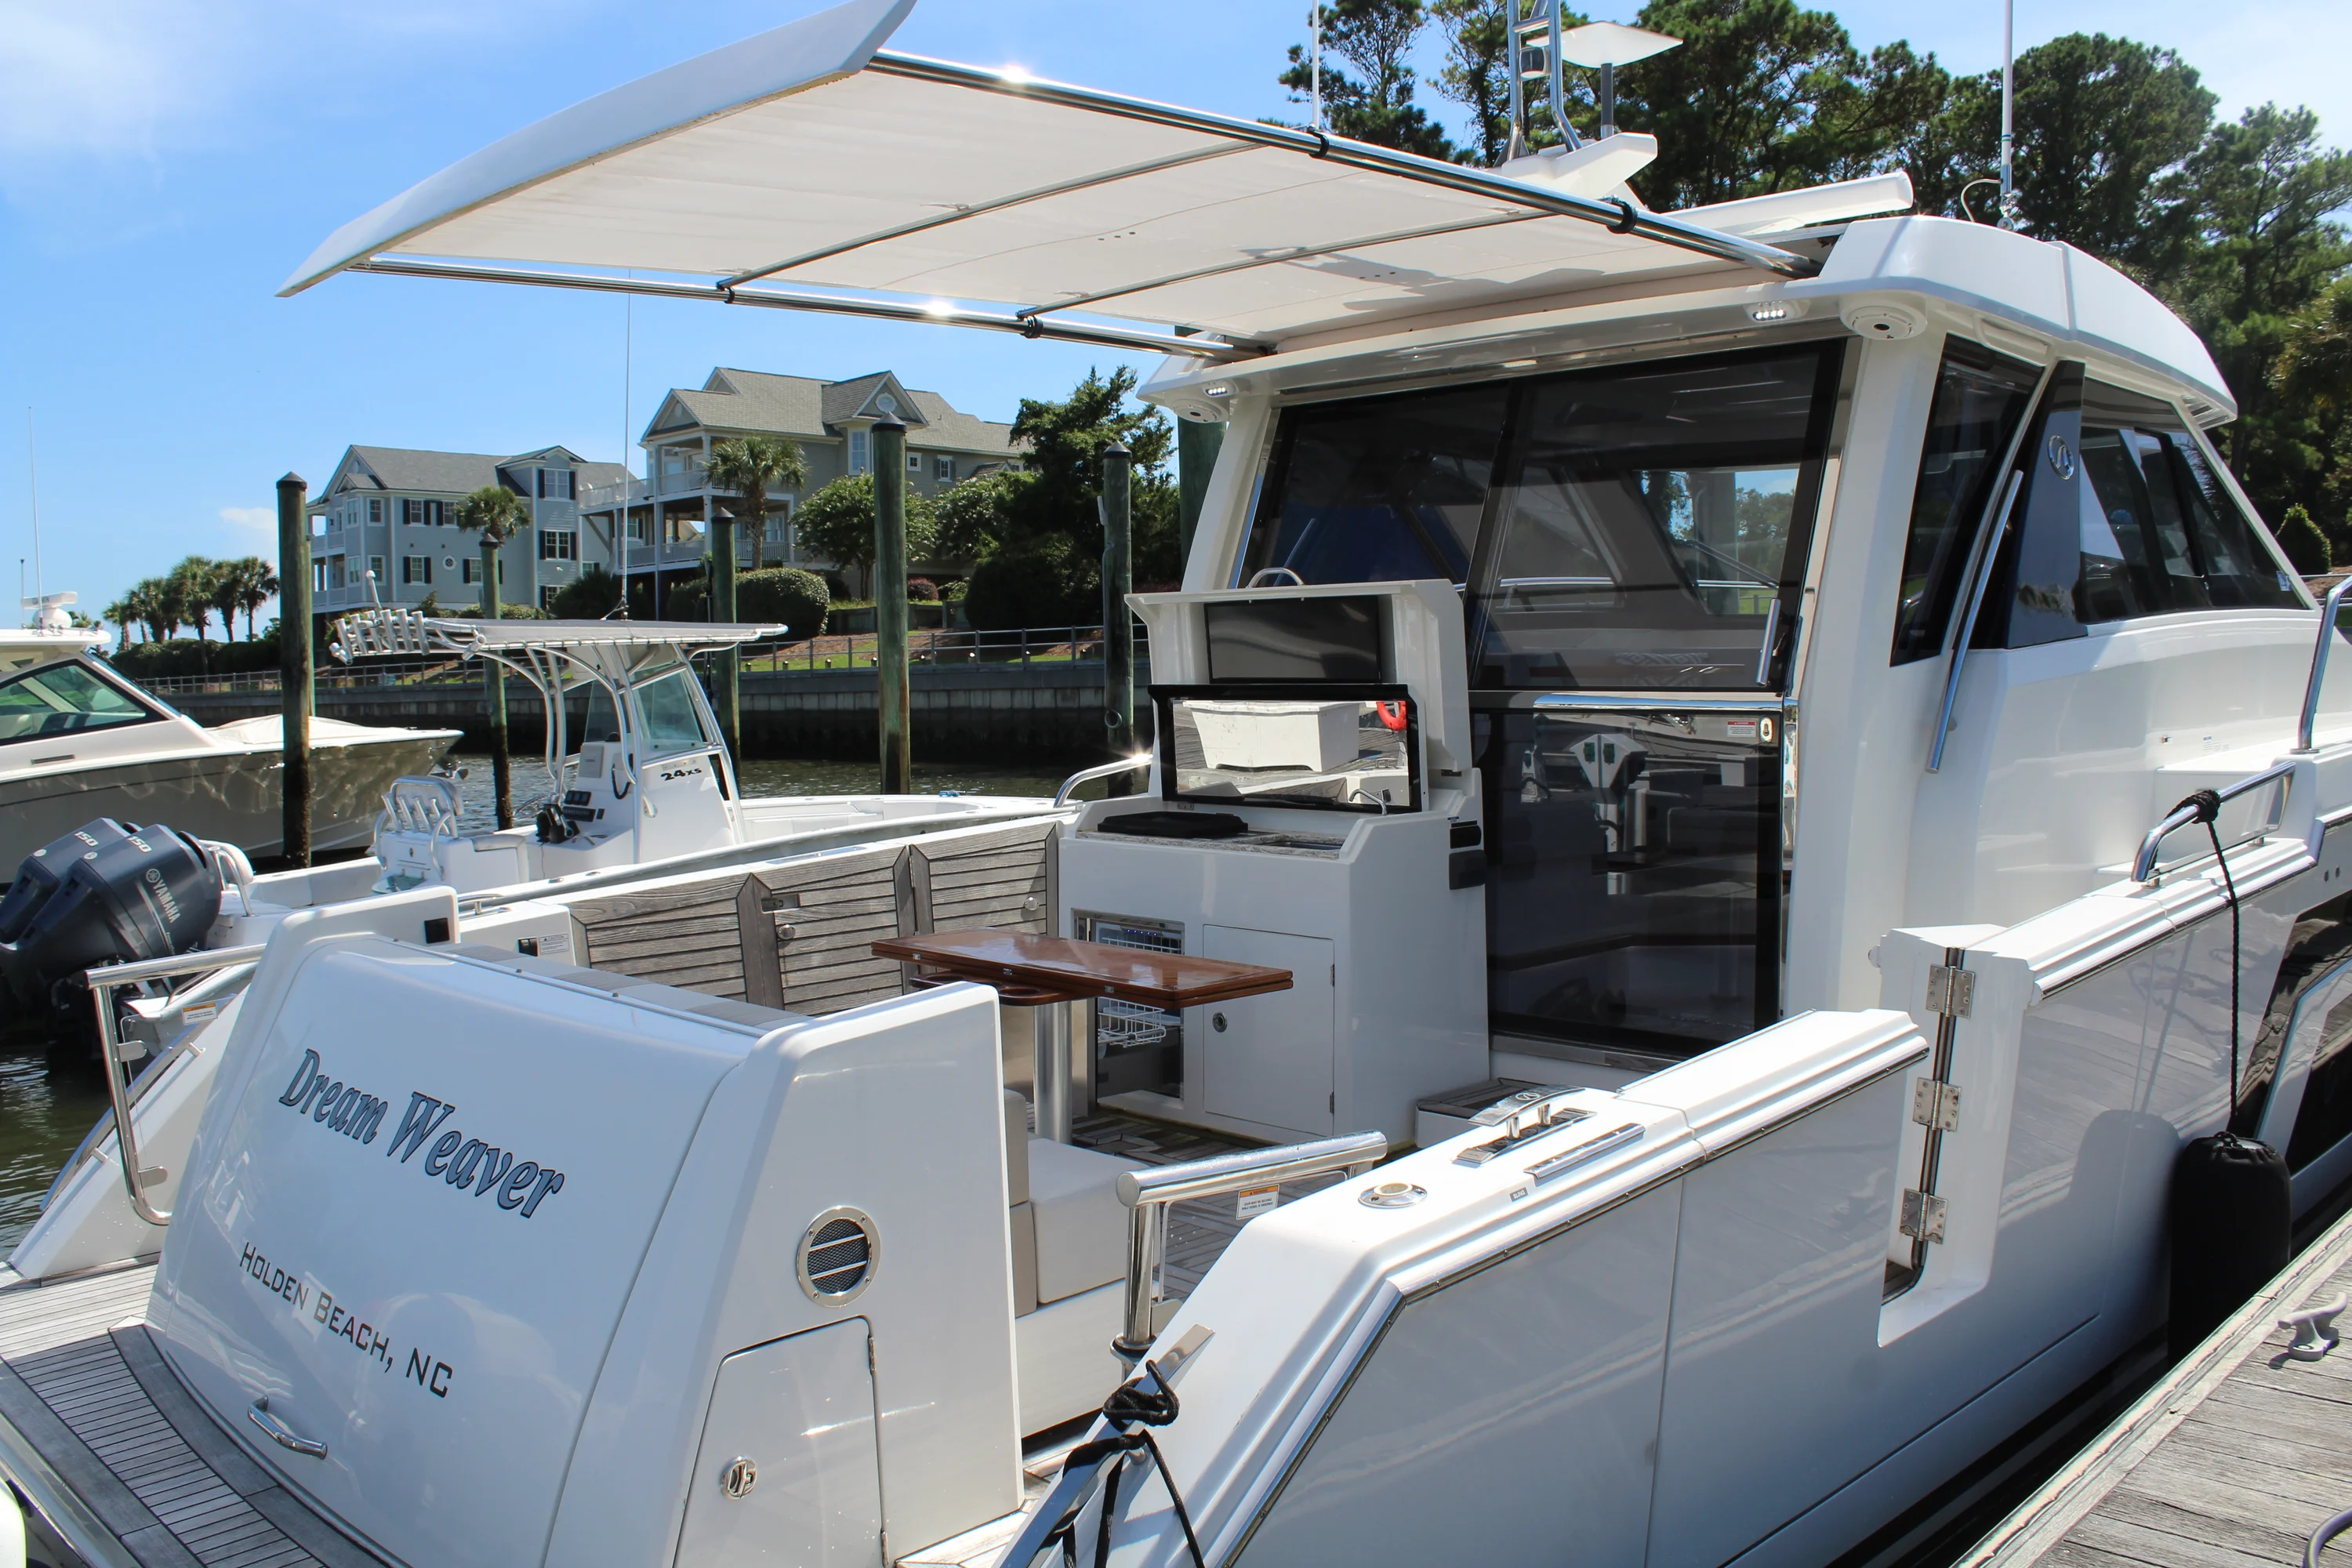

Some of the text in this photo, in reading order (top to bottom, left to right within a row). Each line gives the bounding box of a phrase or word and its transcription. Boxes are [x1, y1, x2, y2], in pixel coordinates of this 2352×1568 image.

[74, 831, 99, 847] 150
[127, 836, 152, 853] 150
[153, 879, 181, 924] YAMAHA
[278, 1047, 565, 1219] Dream Weaver
[1513, 1189, 1525, 1199] SLING
[239, 1242, 453, 1399] HOLDEN BEACH, NC
